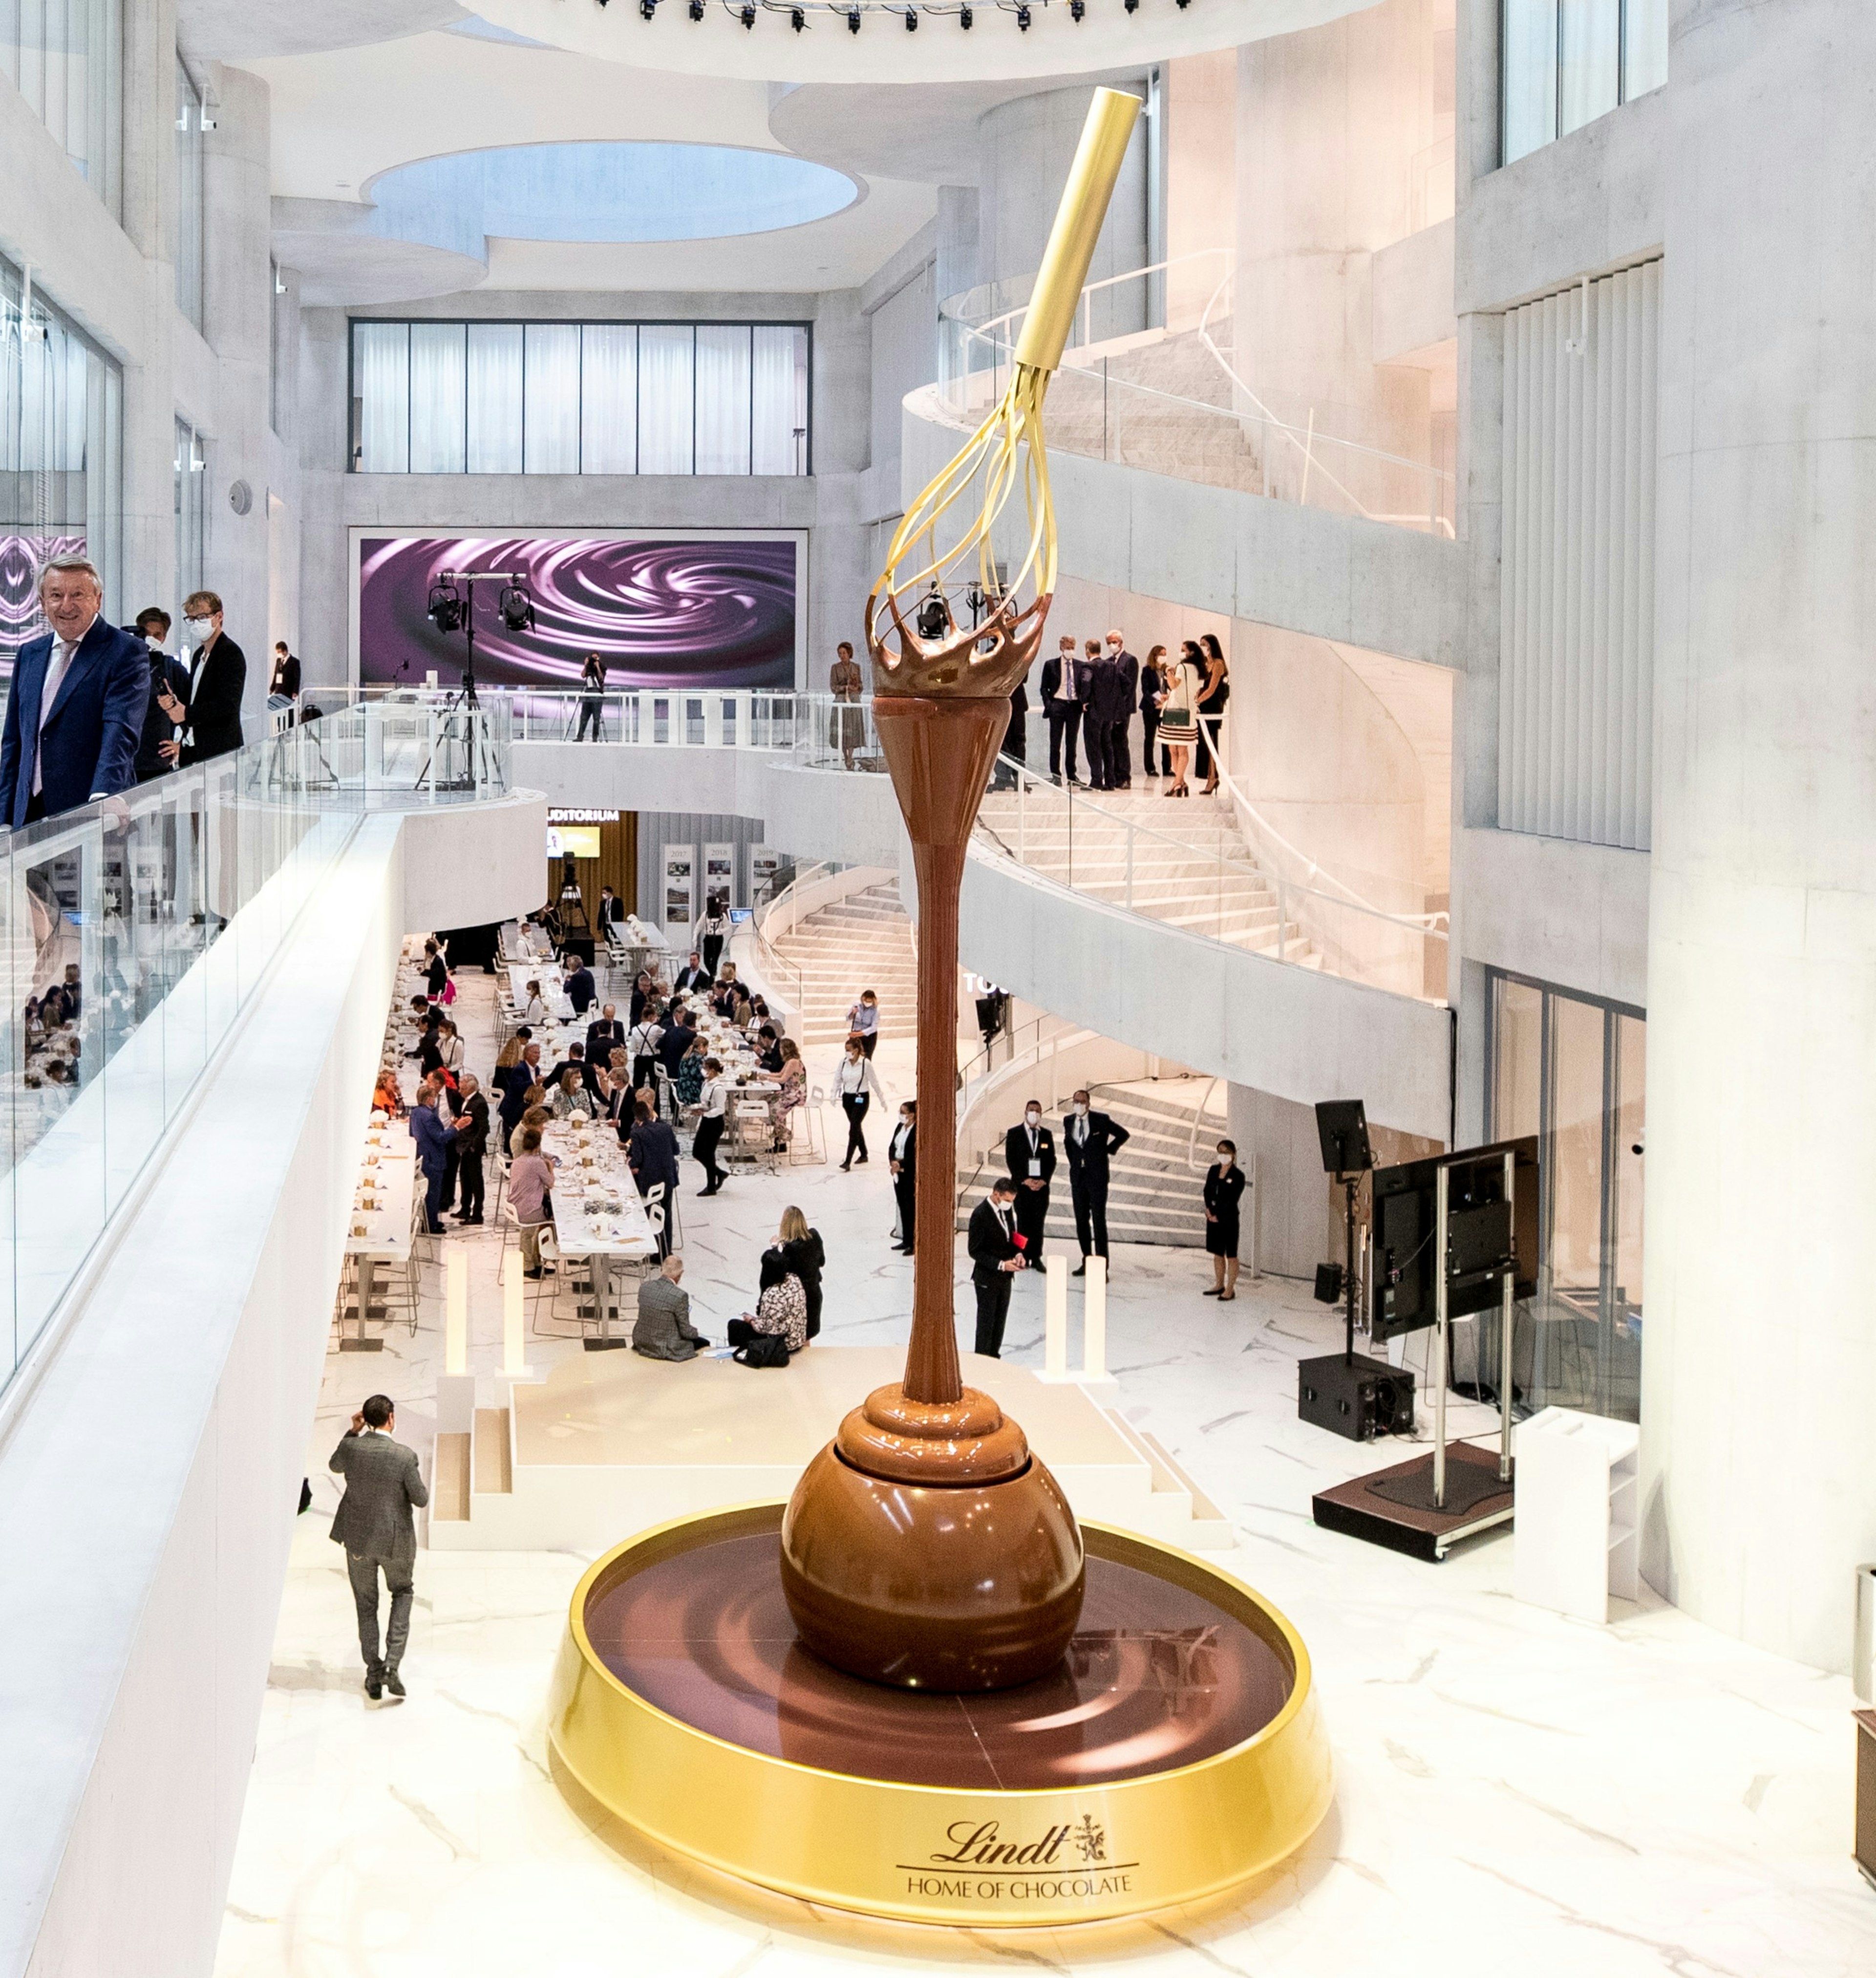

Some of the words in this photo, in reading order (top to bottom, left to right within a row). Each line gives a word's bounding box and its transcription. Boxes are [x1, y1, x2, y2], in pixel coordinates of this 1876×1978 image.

[962, 973, 1009, 994] TO
[930, 1821, 1071, 1865] Lindt
[908, 1877, 972, 1896] HOME
[978, 1882, 1004, 1899] OF
[1010, 1875, 1132, 1899] CHOCOLATE
